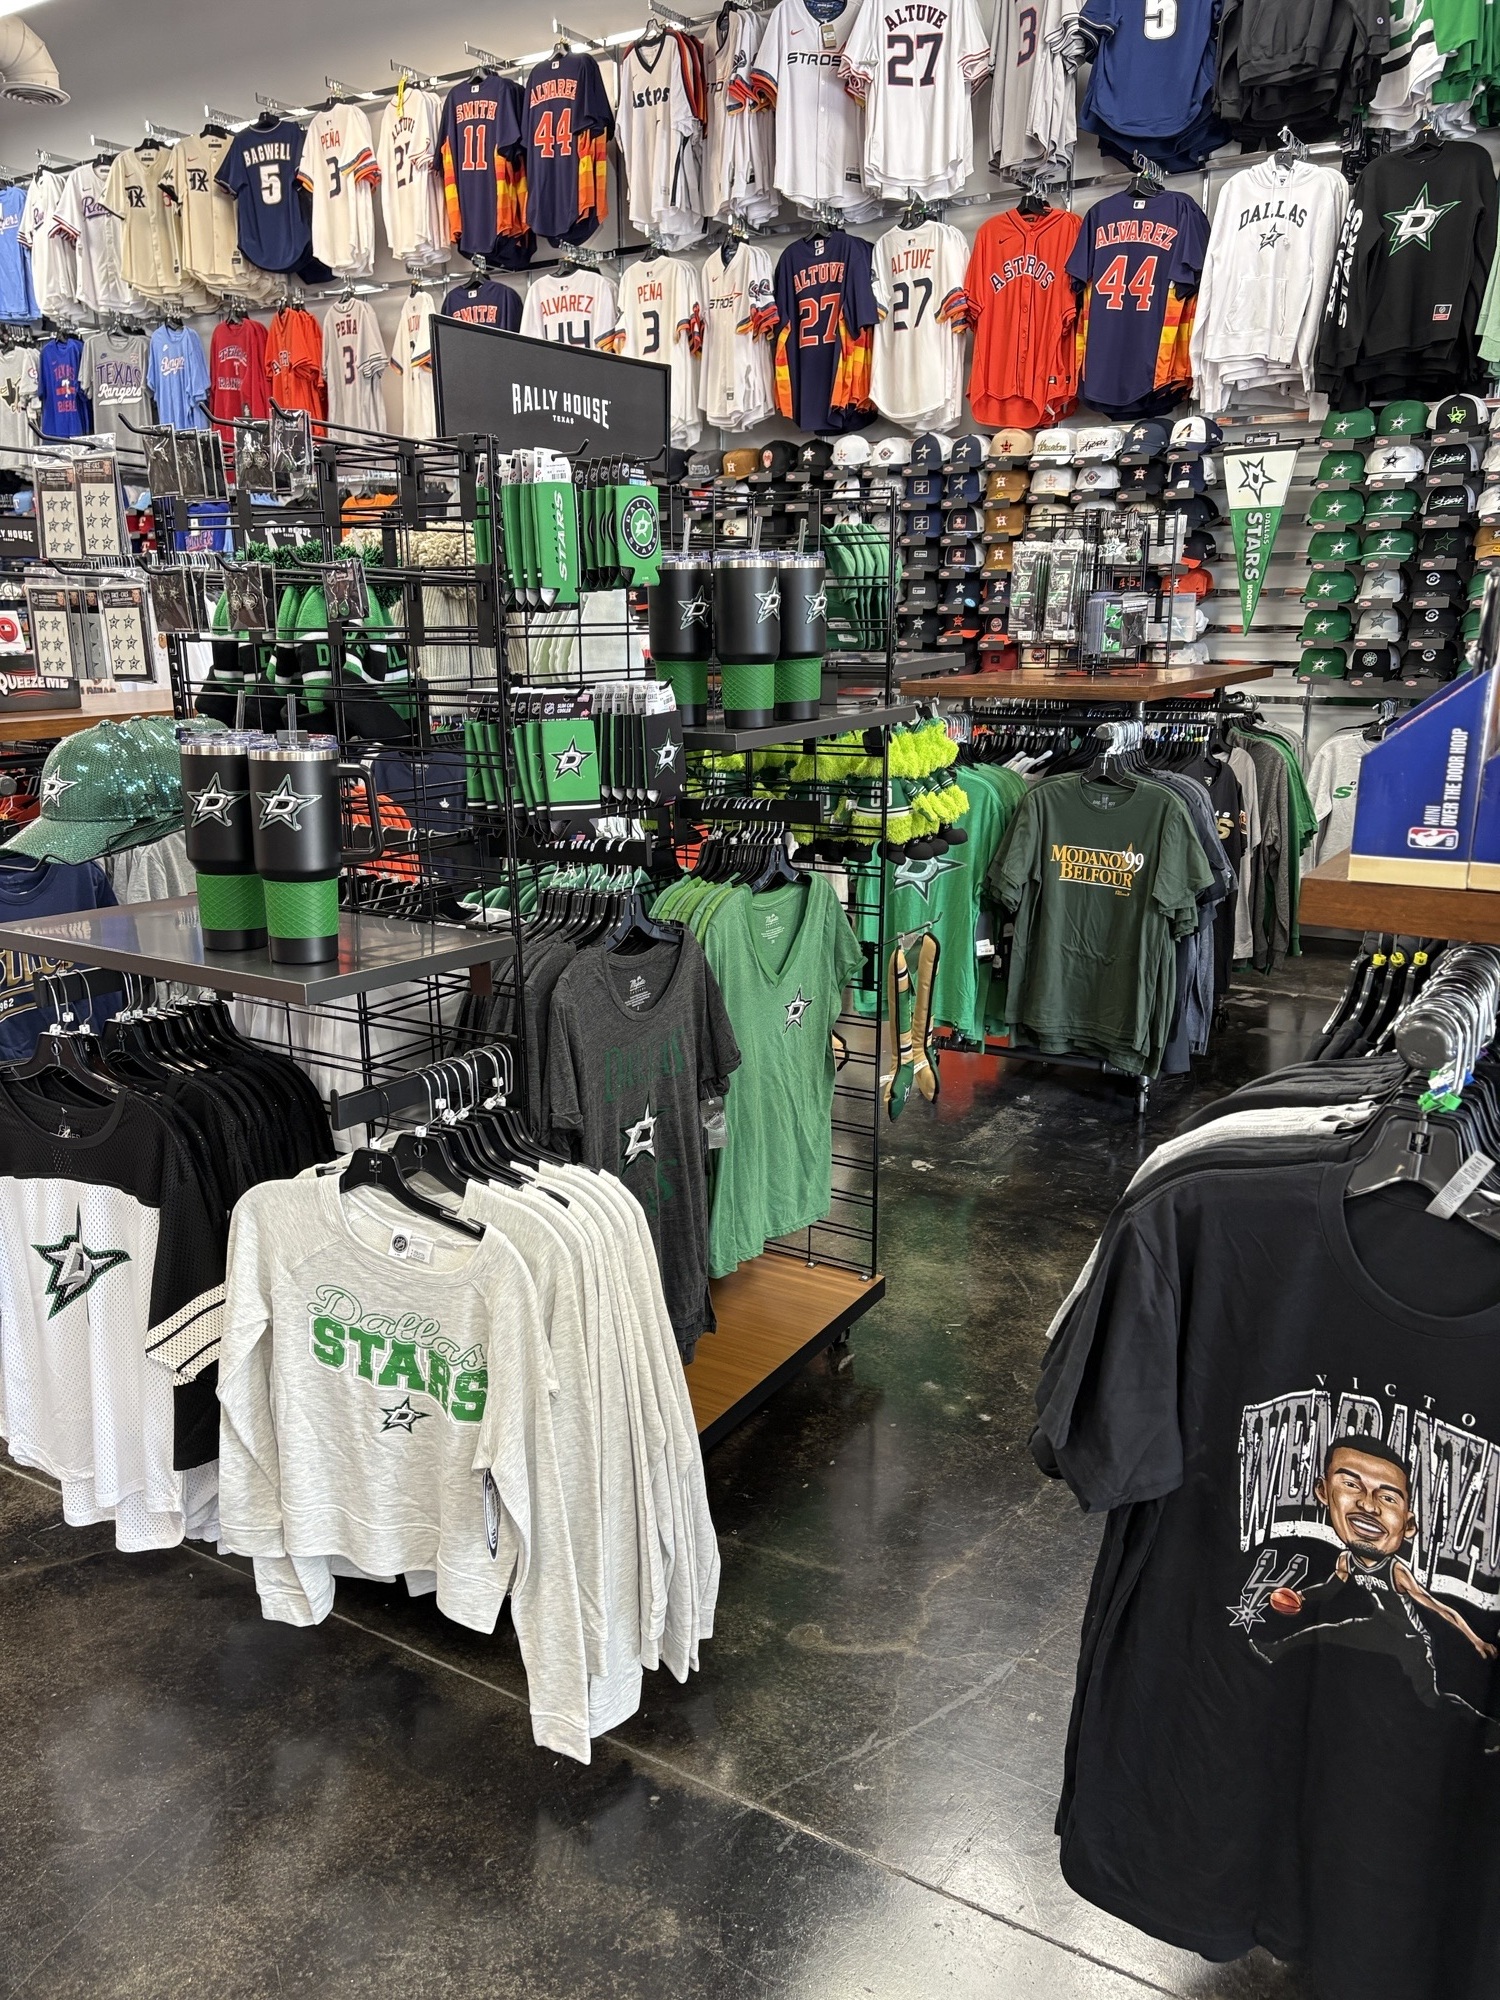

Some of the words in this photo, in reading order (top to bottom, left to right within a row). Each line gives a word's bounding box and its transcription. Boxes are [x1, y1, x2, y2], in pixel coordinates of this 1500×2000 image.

[884, 4, 948, 31] ALTUVE
[1144, 0, 1177, 40] 5
[1017, 6, 1037, 67] 3
[787, 52, 841, 67] STROS
[886, 33, 943, 87] 27
[530, 78, 577, 108] ALVAREZ
[456, 100, 497, 123] SMITH
[321, 128, 341, 151] PEÑA
[462, 124, 488, 170] 11
[534, 108, 572, 158] 44
[243, 143, 291, 167] BAGWELL
[259, 163, 283, 206] 5
[326, 156, 341, 199] 3
[1238, 200, 1307, 231] DALLAS
[1095, 220, 1178, 251] ALVAREZ
[891, 248, 935, 276] ALTUVE
[989, 253, 1056, 295] ASTROS
[1338, 208, 1364, 329] STARS
[637, 280, 663, 304] PEÑA
[794, 262, 845, 294] ALTUVE
[1095, 255, 1158, 311] 44
[452, 305, 498, 324] SMITH
[540, 295, 594, 317] ALVAREZ
[892, 277, 933, 332] 27
[544, 320, 590, 348] 44
[642, 310, 660, 355] 3
[799, 293, 842, 348] 27
[96, 361, 142, 387] TEXAS
[342, 345, 356, 385] 3
[98, 383, 142, 404] Rangers
[512, 383, 557, 415] RALLY
[563, 392, 610, 429] HOUSE
[553, 415, 574, 424] TEXAS
[626, 501, 657, 523] DALLAS
[8, 530, 33, 543] HOUSE
[554, 490, 568, 582] STARS
[1263, 513, 1272, 545] DALLAS
[628, 537, 657, 554] STARS
[1244, 512, 1263, 582] STARS
[1245, 585, 1253, 612] HOCKEY
[45, 678, 69, 689] ME
[1449, 728, 1469, 754] HOOP
[1446, 755, 1465, 781] DOOR
[1443, 782, 1462, 801] THE
[1423, 805, 1441, 826] MINI
[1440, 802, 1459, 827] OVER
[1050, 845, 1121, 868] MODANO
[1060, 862, 1132, 888] BELFOUR
[307, 1284, 487, 1371] Dallas
[309, 1315, 488, 1426] STARS
